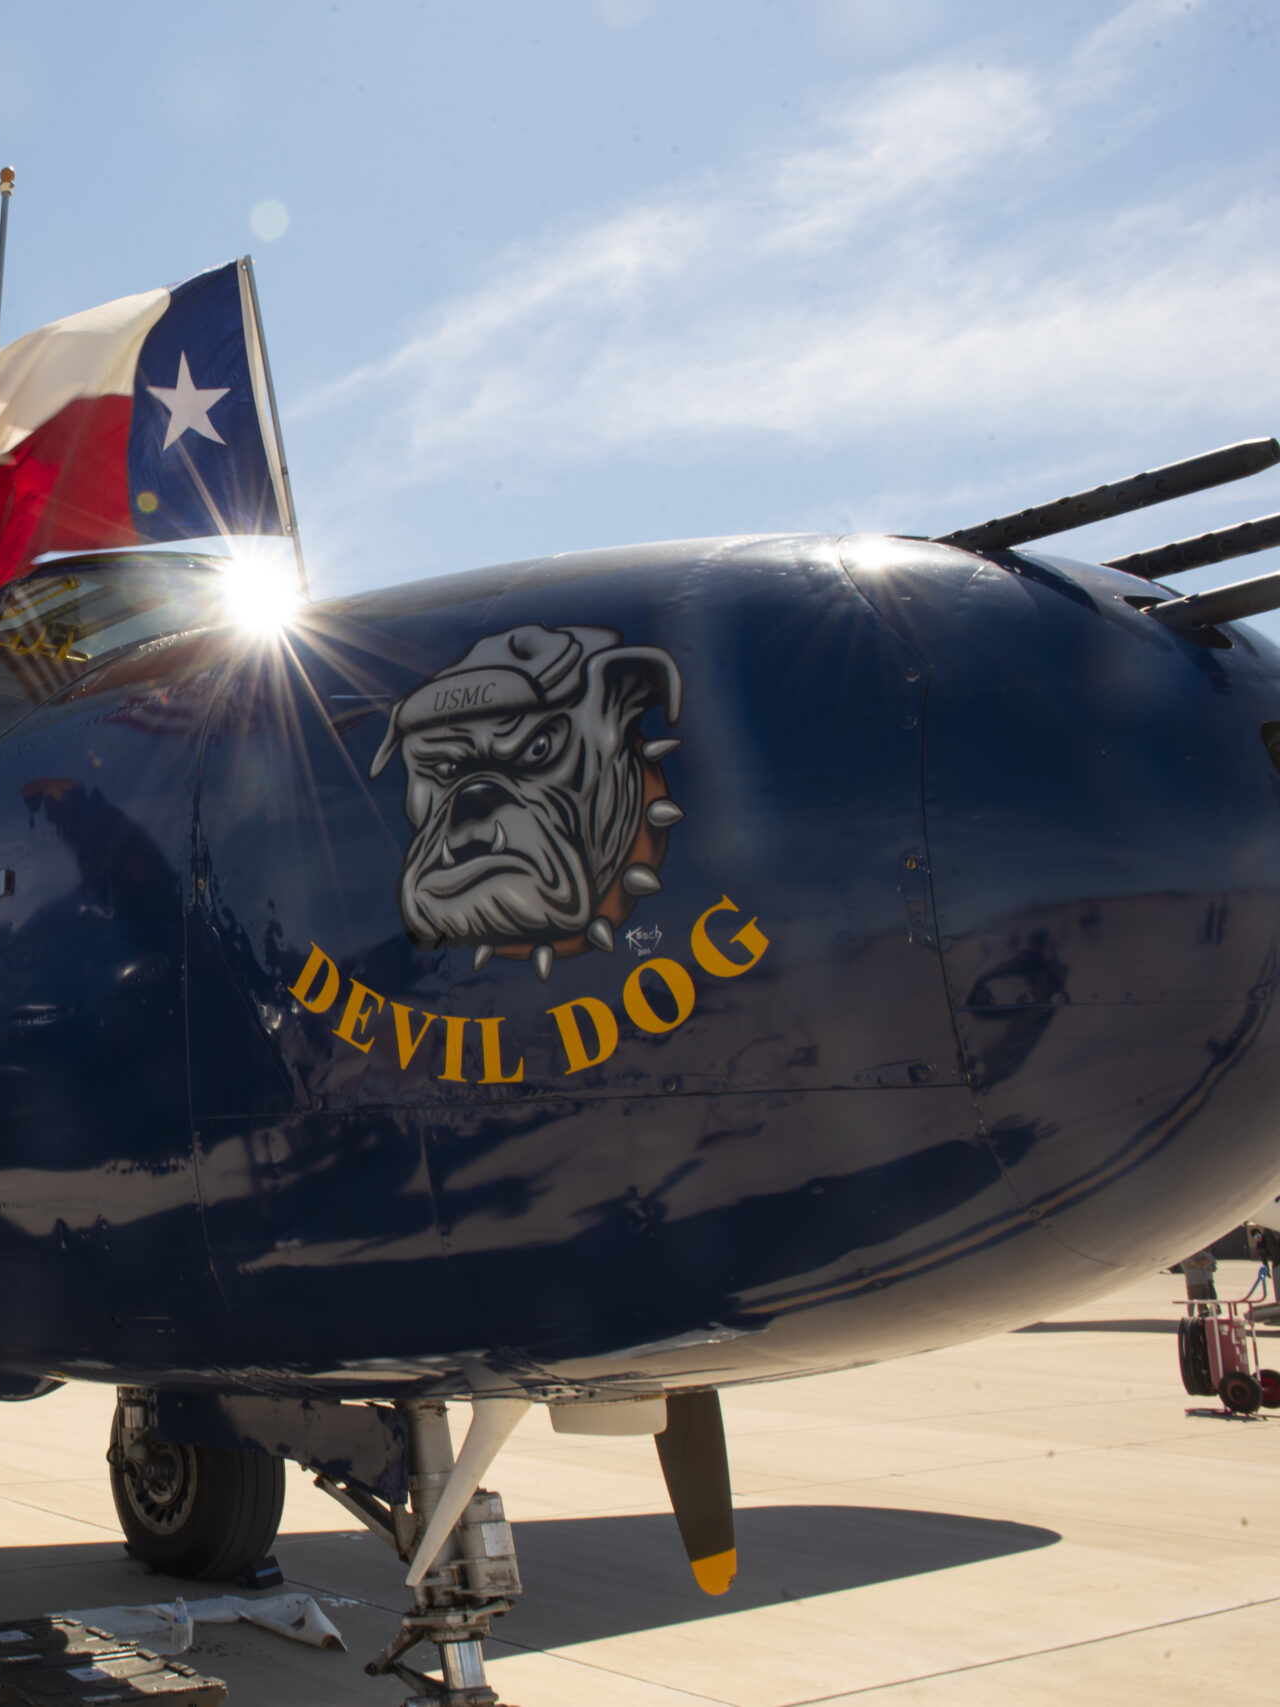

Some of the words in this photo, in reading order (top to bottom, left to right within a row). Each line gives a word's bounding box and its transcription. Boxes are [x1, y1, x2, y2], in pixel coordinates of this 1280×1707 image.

[433, 682, 496, 712] USMC
[287, 941, 524, 1084] DEVIL
[545, 894, 770, 1075] DOG
